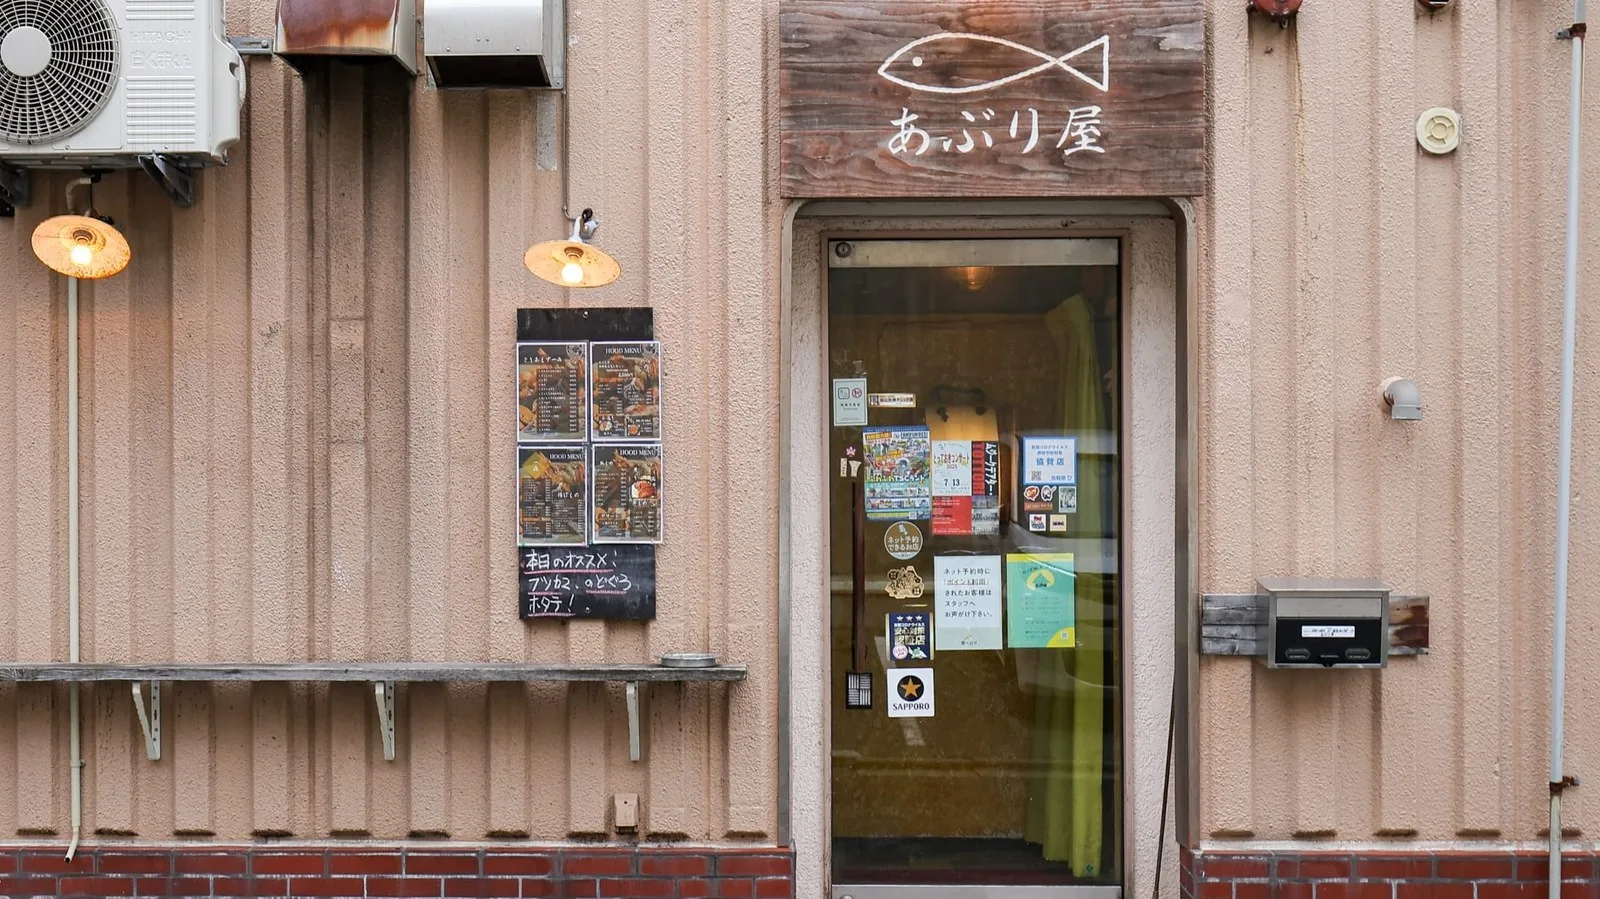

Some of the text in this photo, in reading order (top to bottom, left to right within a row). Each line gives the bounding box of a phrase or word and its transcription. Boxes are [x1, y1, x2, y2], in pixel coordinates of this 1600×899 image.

[129, 31, 191, 43] HITACHI
[888, 105, 1105, 155] あぶり屋
[888, 543, 919, 551] できるお店
[945, 589, 992, 597] されたお客様は
[945, 610, 993, 618] お声がけ下さい。
[892, 703, 930, 711] SAPPORO
